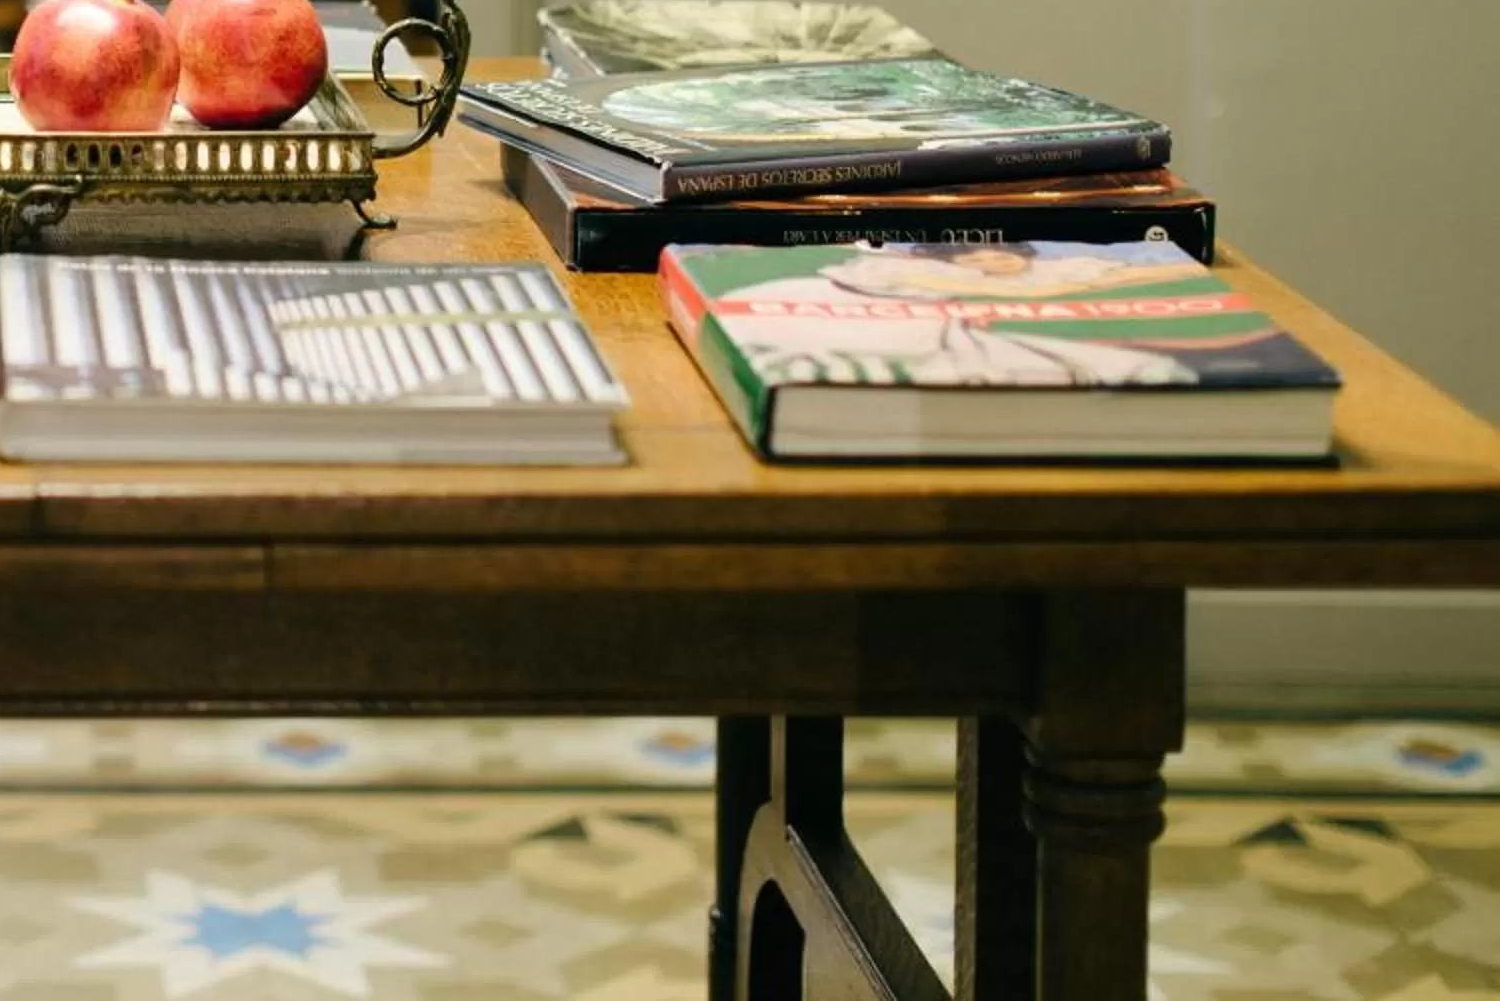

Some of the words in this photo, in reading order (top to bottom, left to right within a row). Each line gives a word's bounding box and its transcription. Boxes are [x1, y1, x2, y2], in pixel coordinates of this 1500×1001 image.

[762, 167, 832, 185] SECRETOS
[835, 159, 901, 182] JARDINES
[738, 172, 758, 189] DE
